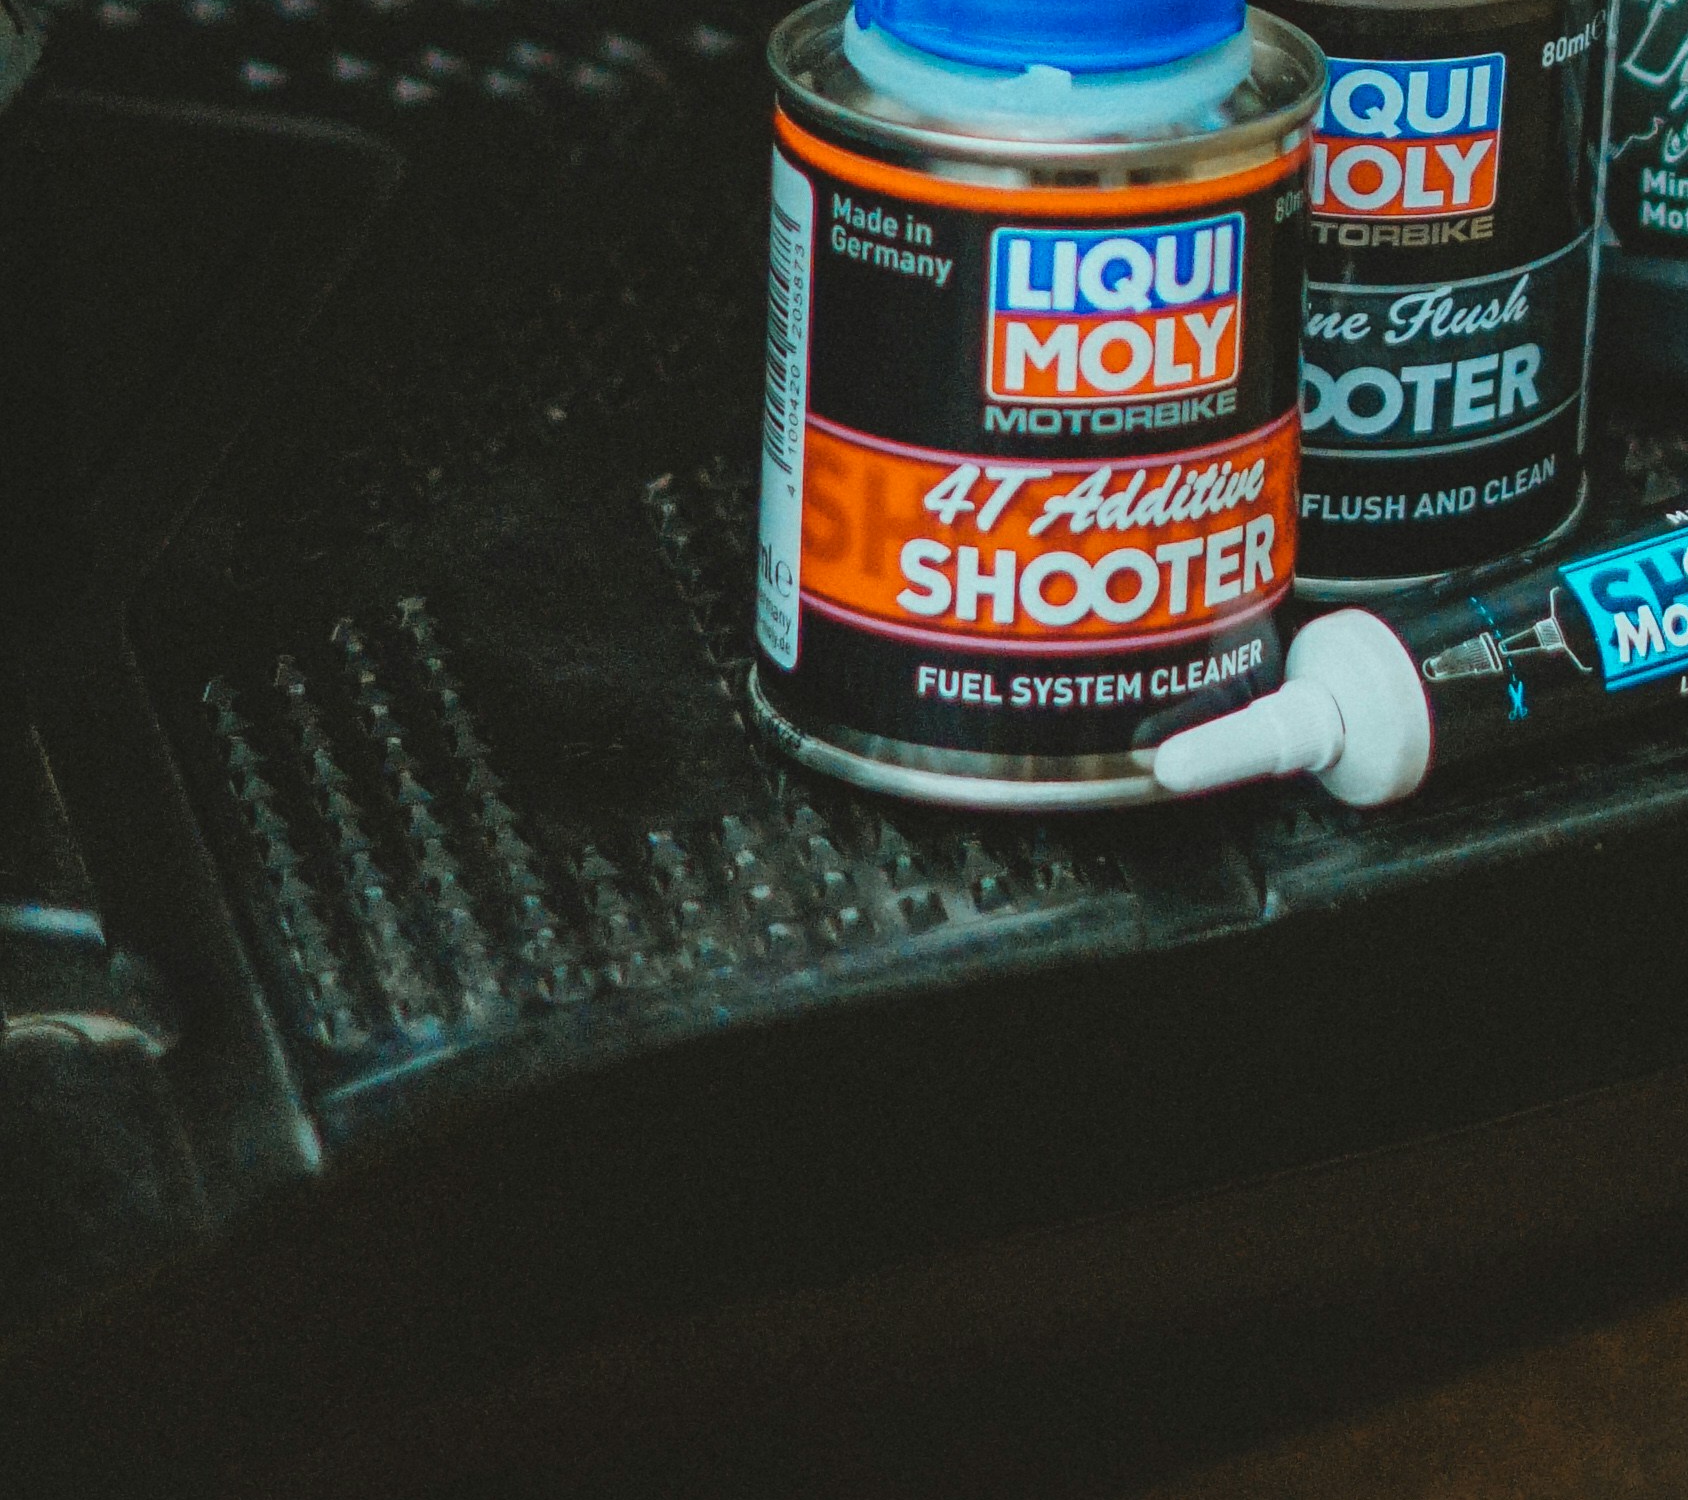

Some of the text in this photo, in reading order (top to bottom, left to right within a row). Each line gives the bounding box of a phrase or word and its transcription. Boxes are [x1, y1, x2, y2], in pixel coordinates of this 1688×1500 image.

[1313, 65, 1491, 139] QUI
[1311, 139, 1495, 211] OLY
[832, 193, 933, 247] Made in
[1310, 214, 1495, 247] TORBIKE
[831, 224, 953, 288] Germany
[1007, 224, 1233, 314] LIQUI
[1383, 273, 1529, 344] Flush
[1004, 305, 1235, 392] MOLY
[984, 388, 1238, 436] MOTORBIKE
[1300, 342, 1541, 435] OOTER
[923, 462, 1053, 532] 4T
[1027, 458, 1265, 537] Additive
[1302, 453, 1556, 521] FLUSH AND CLEAN
[896, 512, 1275, 626] SHOOTER
[916, 637, 1264, 707] FUEL SYSTEM CLEANER
